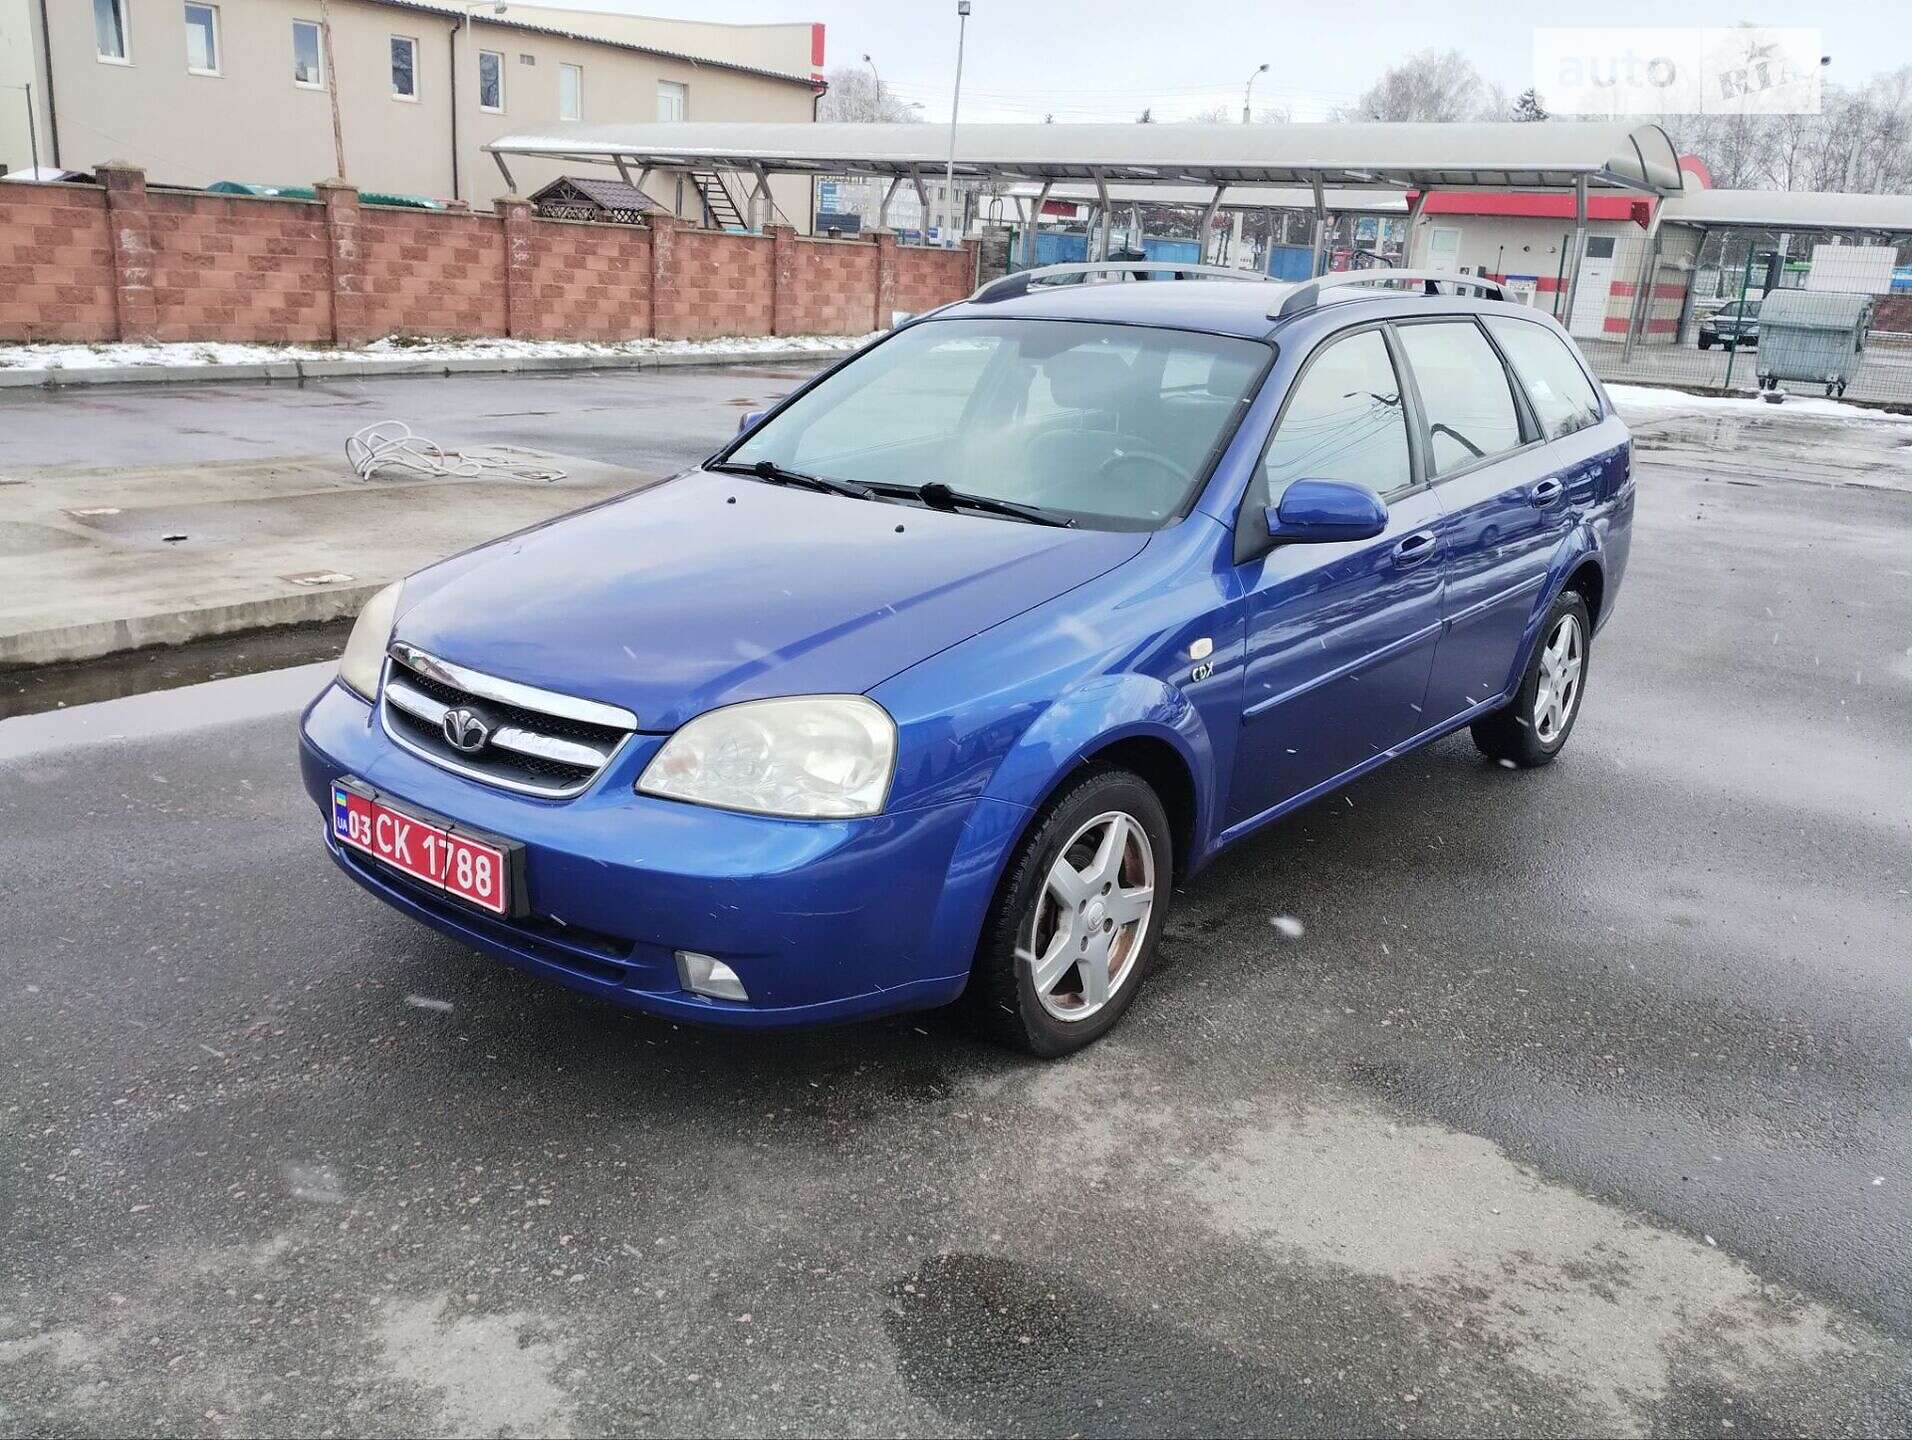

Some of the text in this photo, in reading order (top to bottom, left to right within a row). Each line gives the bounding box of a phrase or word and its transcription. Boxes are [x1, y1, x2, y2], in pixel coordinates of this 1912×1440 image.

[337, 816, 348, 833] UA
[348, 810, 492, 897] 03 CK 1788
